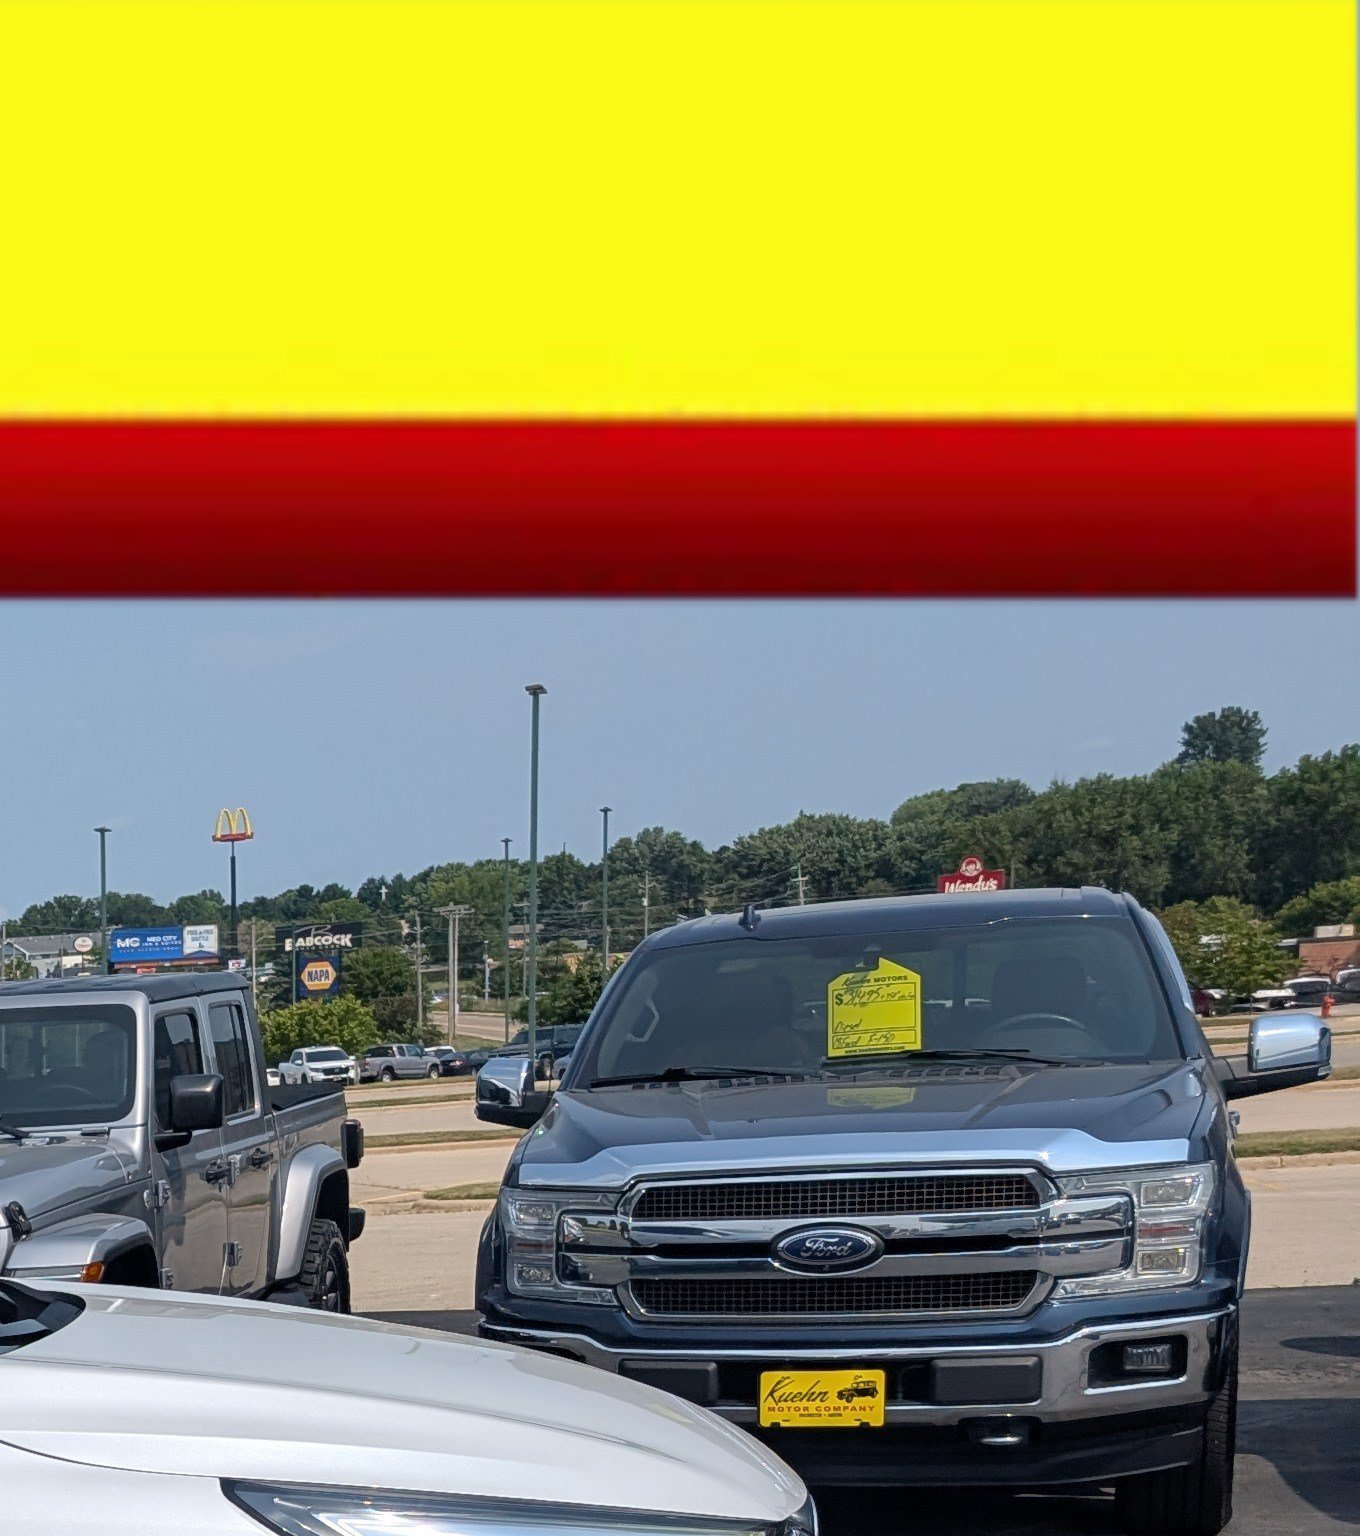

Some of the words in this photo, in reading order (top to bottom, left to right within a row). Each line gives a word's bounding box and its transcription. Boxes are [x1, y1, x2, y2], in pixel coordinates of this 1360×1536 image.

[944, 875, 998, 893] Wendy's
[285, 933, 352, 951] BABCOCK
[307, 969, 330, 982] NAPA
[873, 975, 908, 983] MOTORS
[800, 1237, 853, 1257] Ford
[763, 1379, 831, 1406] Kuehn
[767, 1405, 809, 1413] MOTOR
